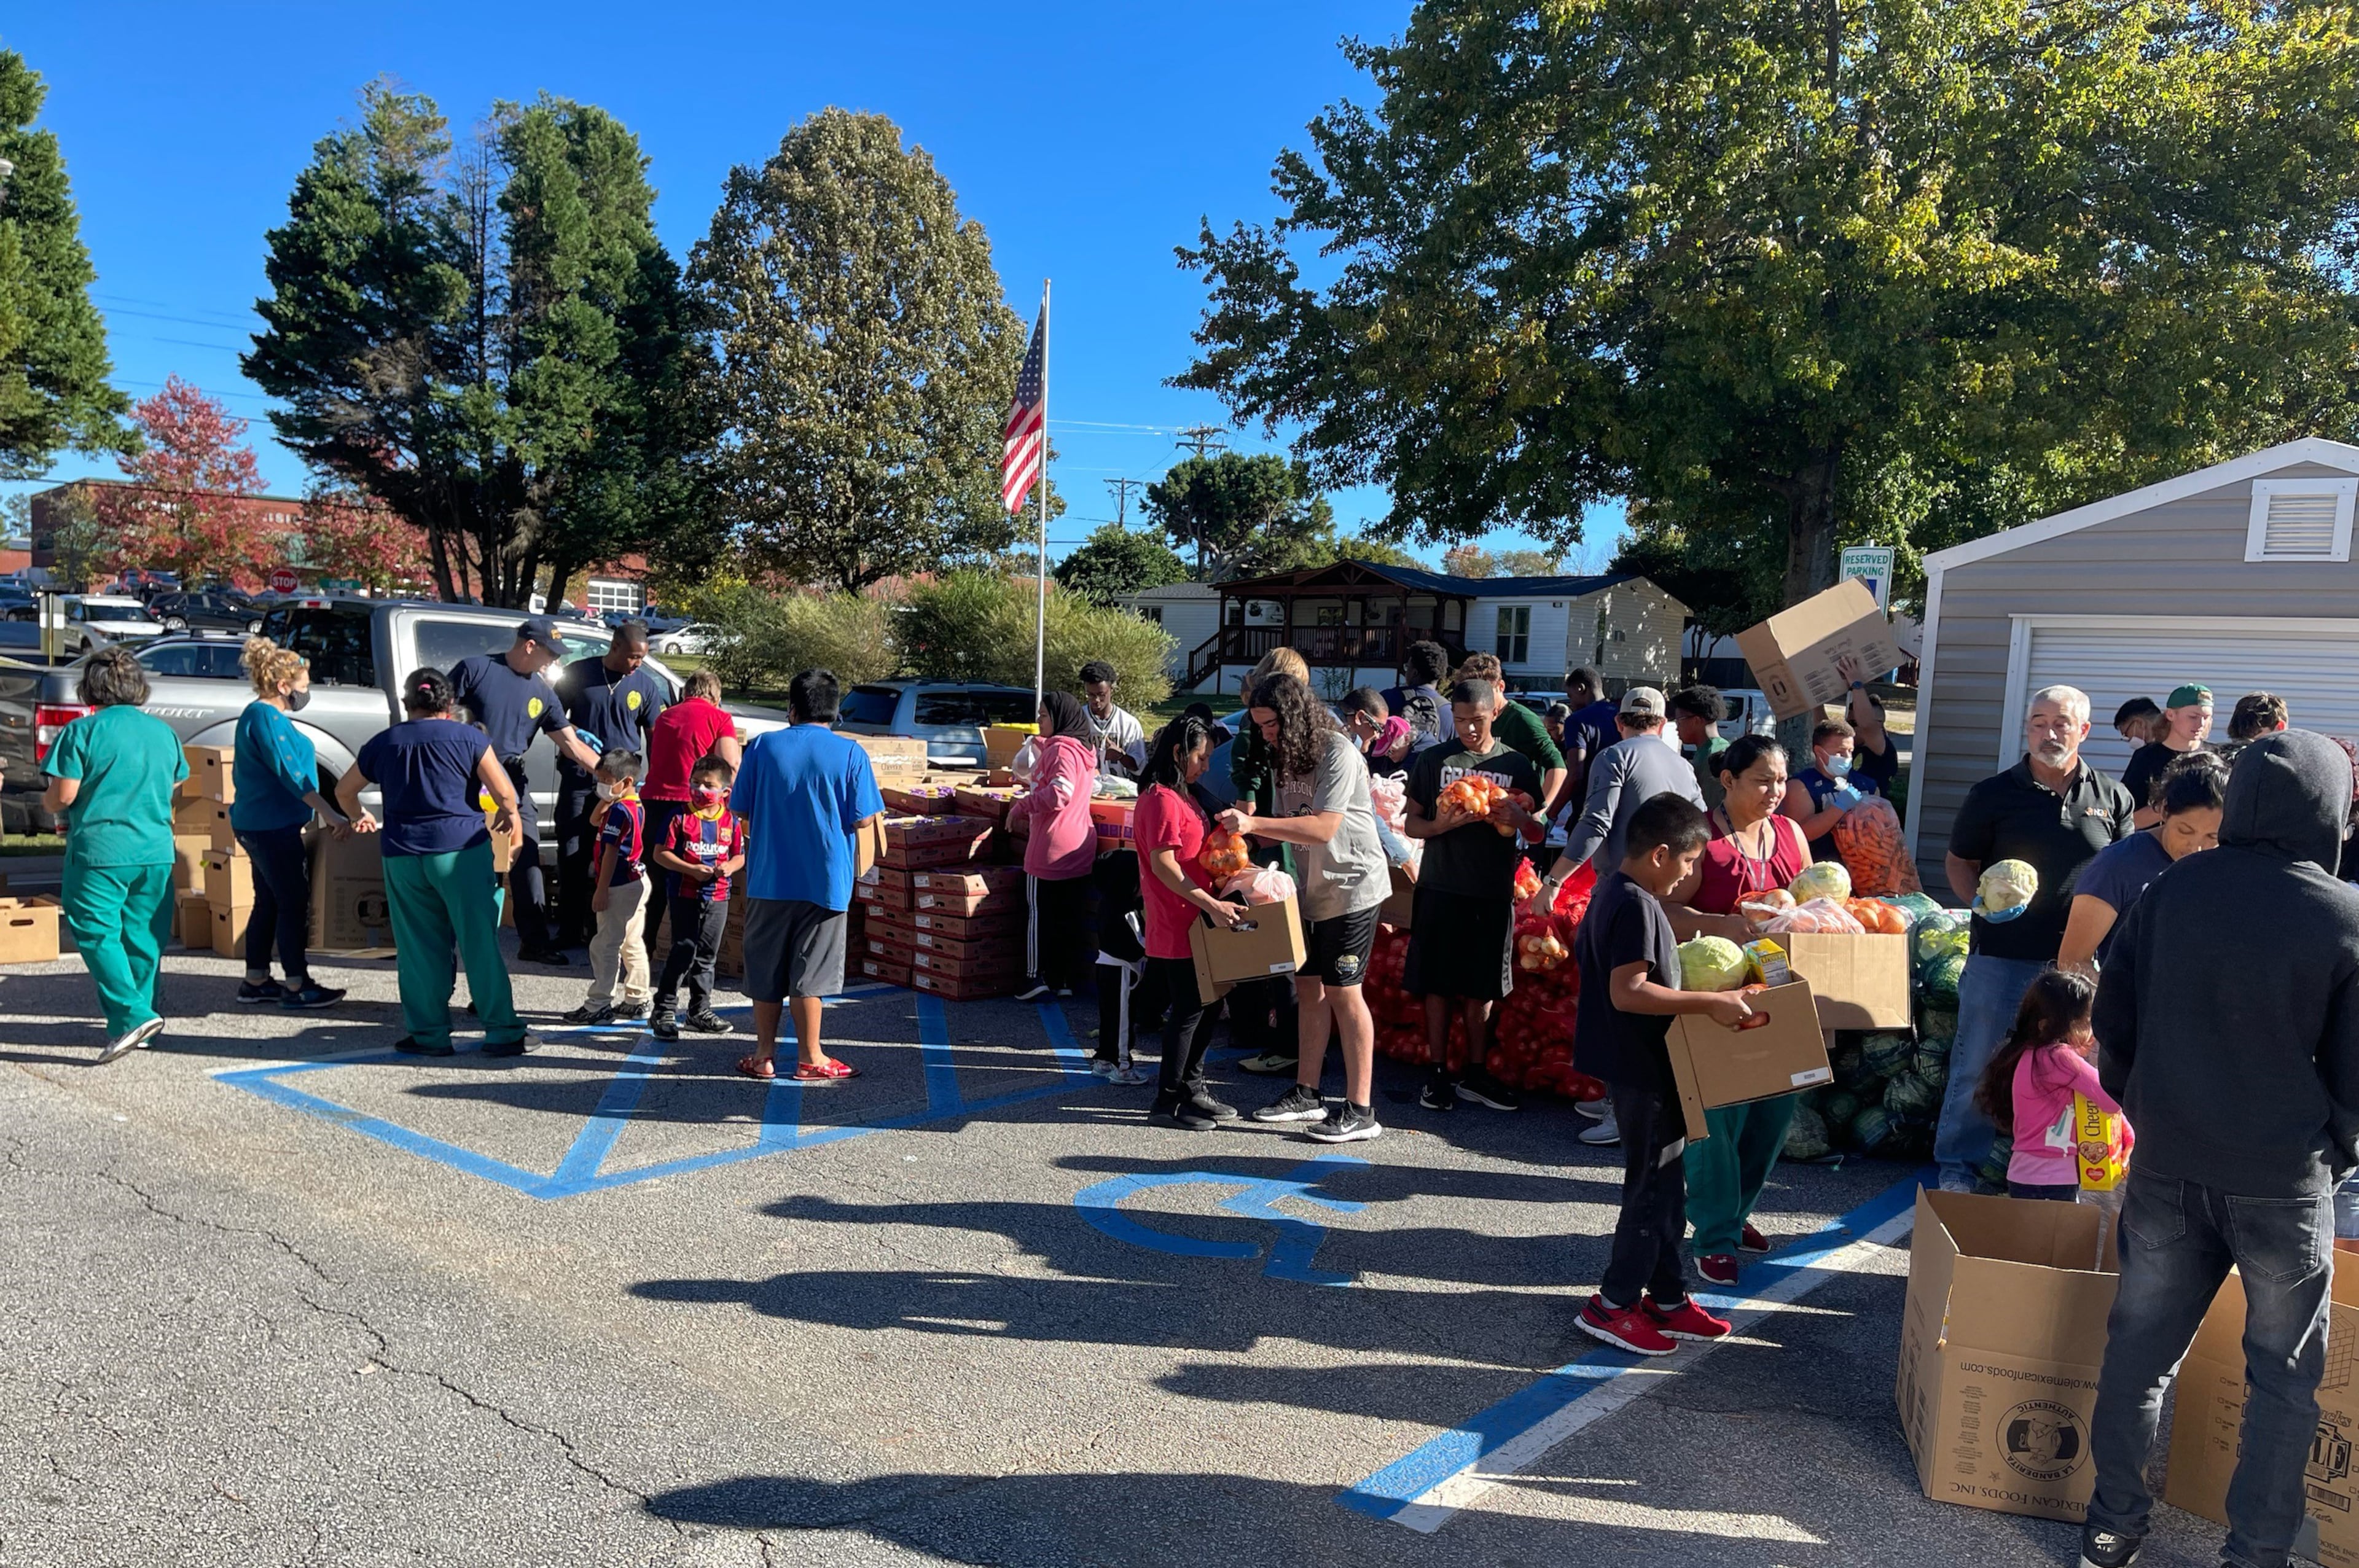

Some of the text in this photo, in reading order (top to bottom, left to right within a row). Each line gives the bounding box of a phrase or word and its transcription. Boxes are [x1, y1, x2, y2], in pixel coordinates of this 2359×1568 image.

[1845, 554, 1888, 564] RESERVED
[1847, 566, 1884, 576] PARKING
[273, 576, 296, 588] STOP
[143, 707, 214, 719] PORT
[2084, 1101, 2101, 1137] Cheer
[1960, 1362, 2097, 1390] w.olemexicanfoods.com
[2016, 1401, 2076, 1420] AUTHENTIC
[2006, 1454, 2075, 1481] LA BANDERITA
